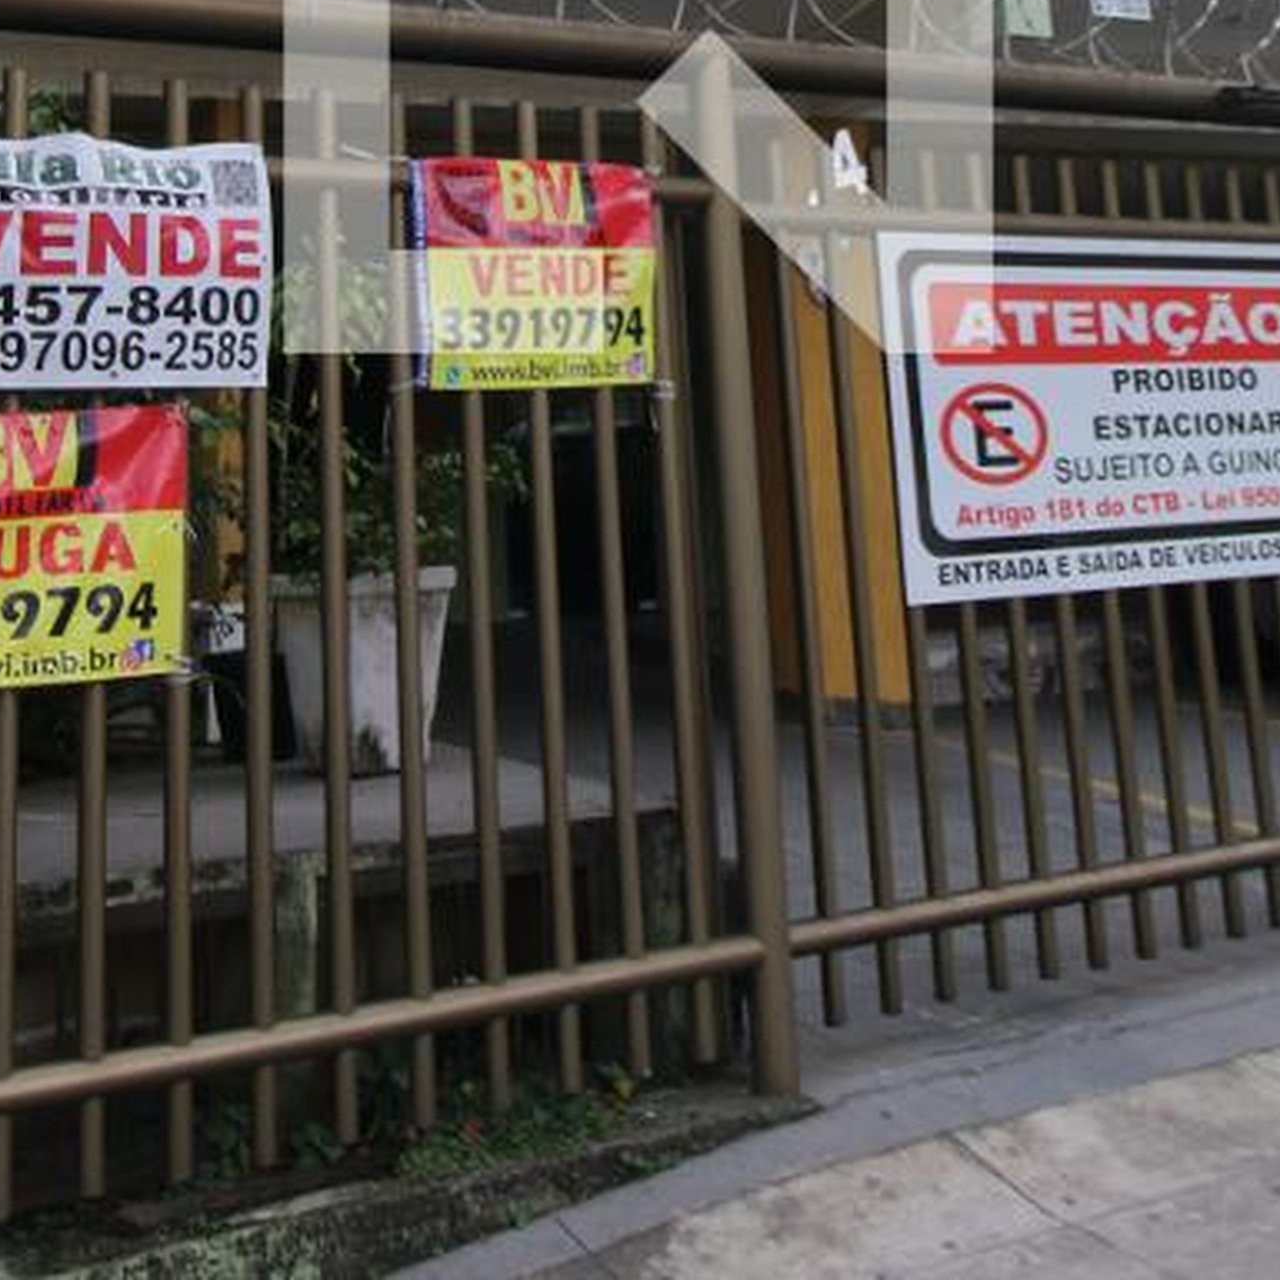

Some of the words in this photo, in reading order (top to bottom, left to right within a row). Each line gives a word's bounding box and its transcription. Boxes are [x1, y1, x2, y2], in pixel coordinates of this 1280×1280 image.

[468, 254, 630, 297] VENDE
[440, 307, 645, 349] 33919794
[0, 331, 258, 371] 97096-2585
[1112, 368, 1258, 393] PROIBIDO
[1054, 451, 1175, 484] SUJEITO
[1183, 451, 1200, 477] A
[957, 503, 1035, 528] Artigo
[1045, 498, 1086, 520] 181
[1096, 495, 1124, 518] do
[1132, 491, 1180, 514] CTB
[938, 558, 1050, 586] ENTRADA
[1057, 556, 1071, 577] E
[1150, 546, 1177, 569] DE
